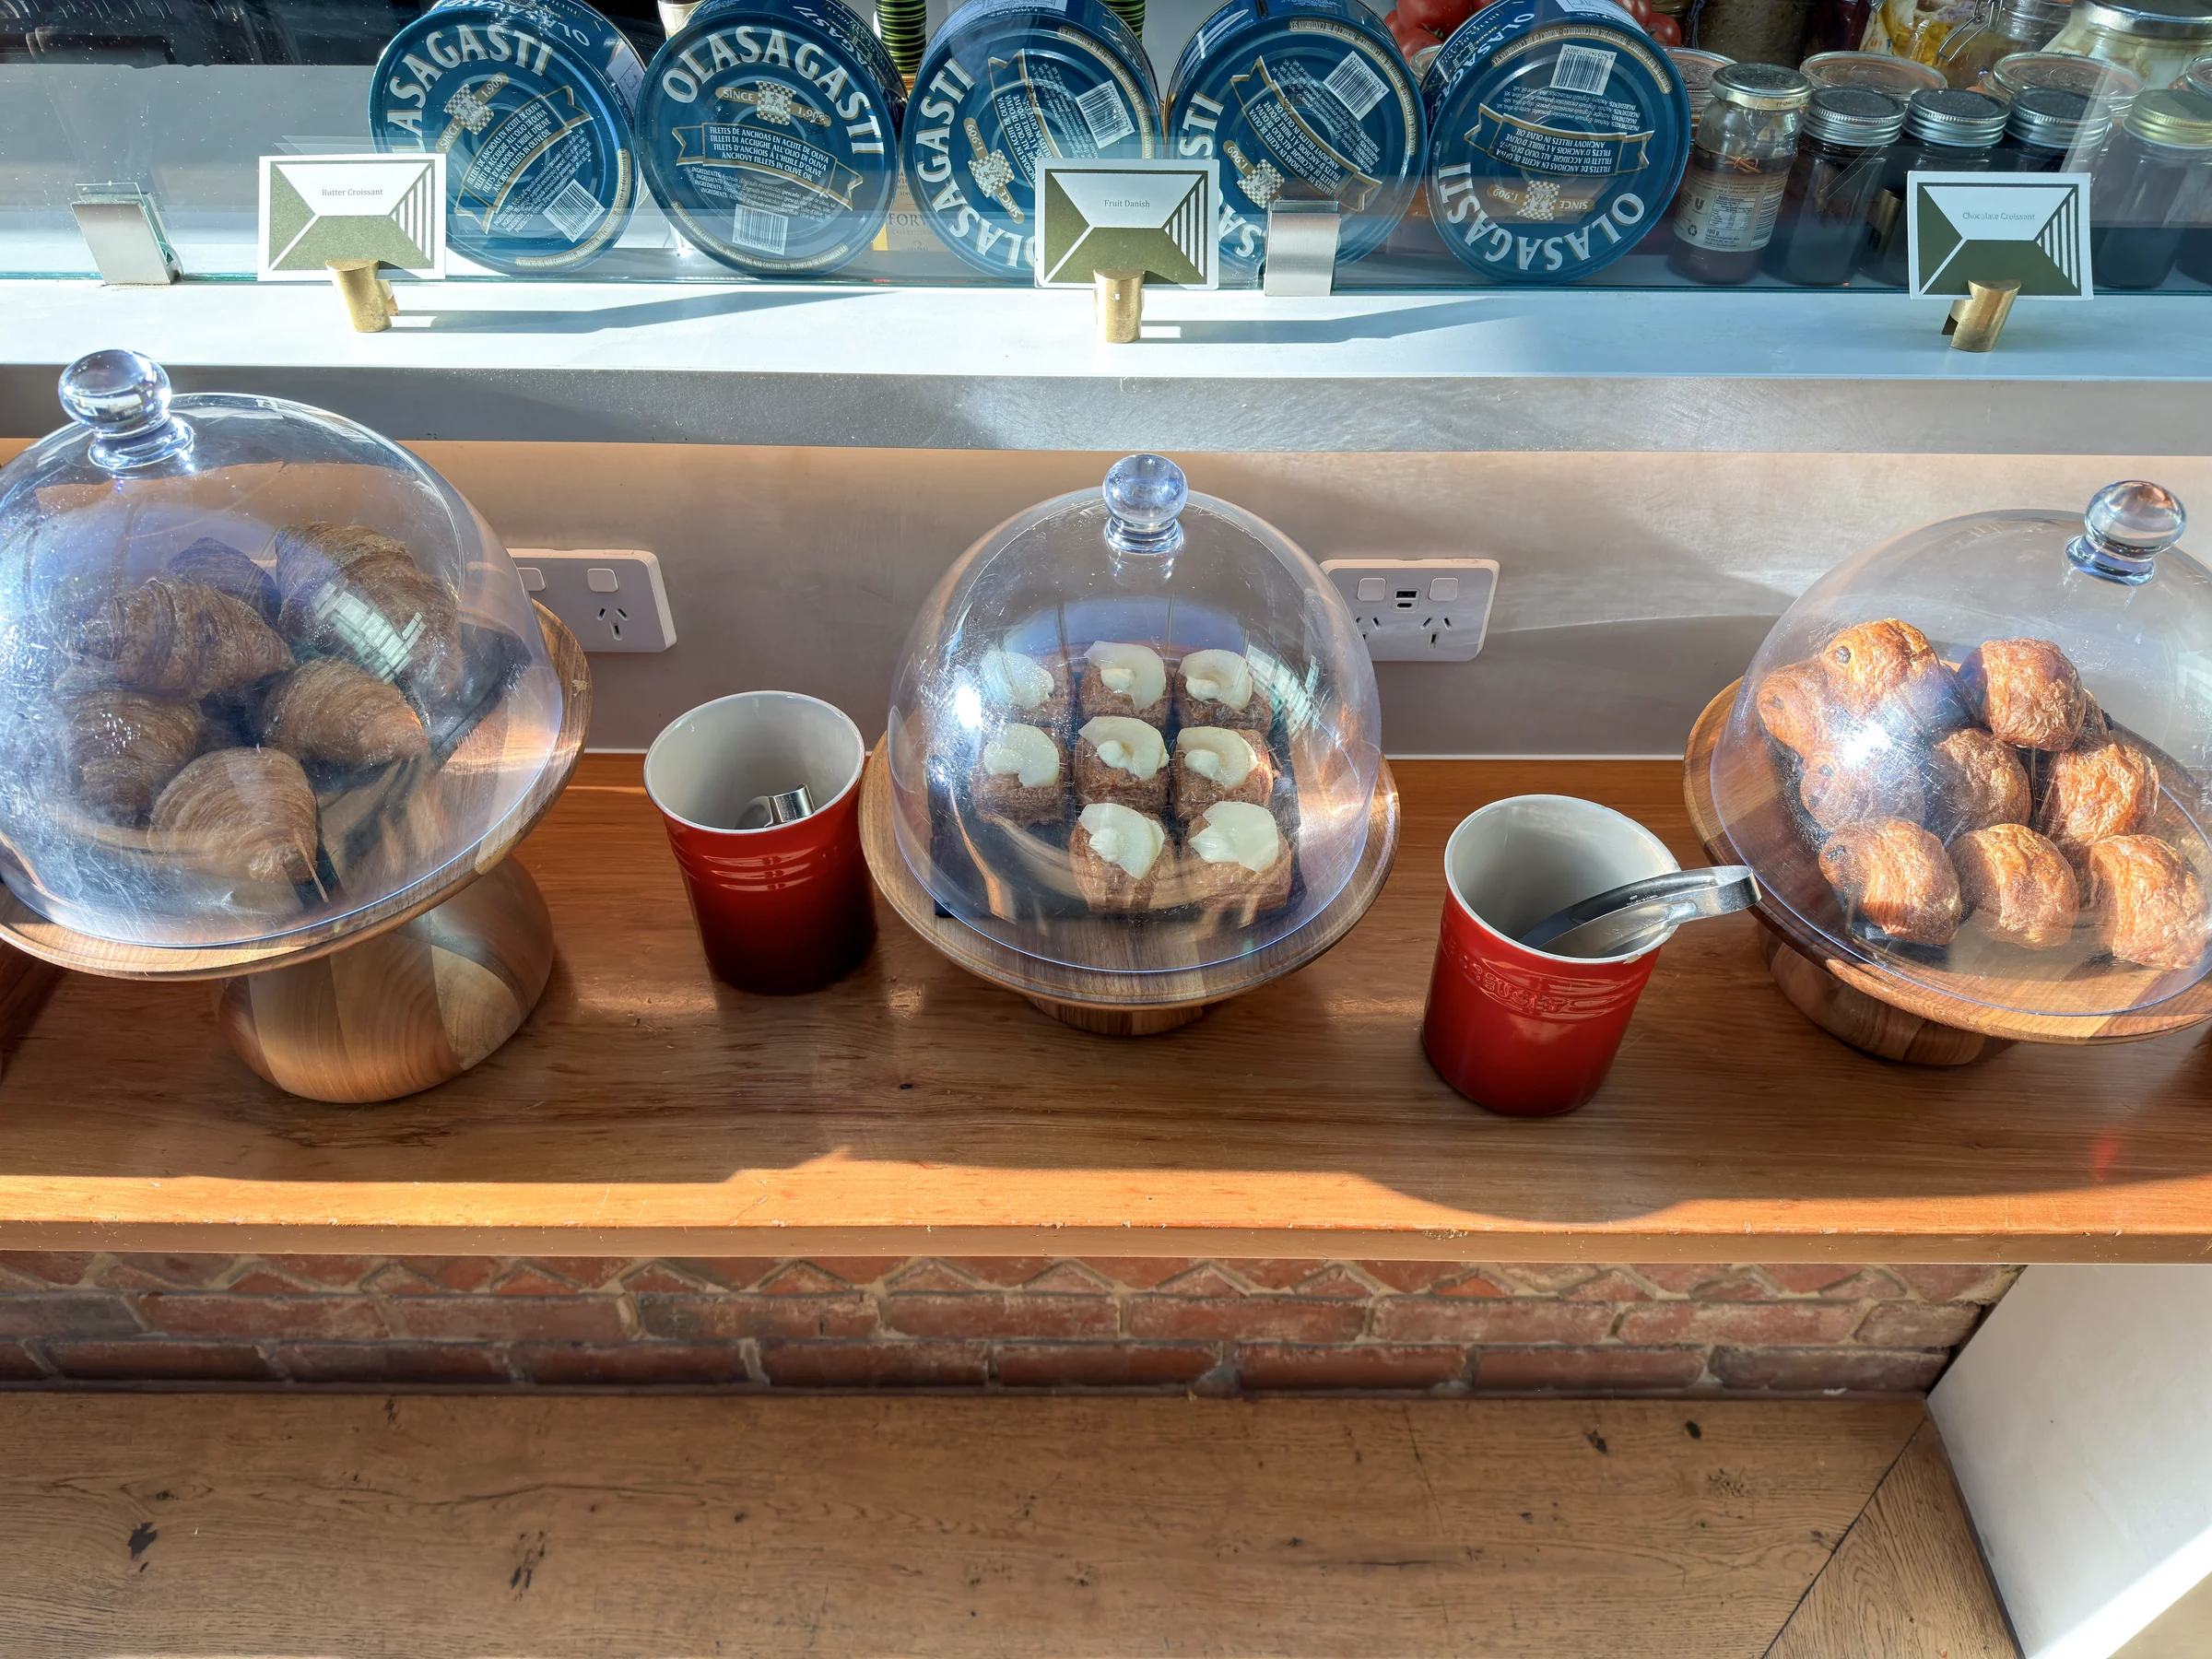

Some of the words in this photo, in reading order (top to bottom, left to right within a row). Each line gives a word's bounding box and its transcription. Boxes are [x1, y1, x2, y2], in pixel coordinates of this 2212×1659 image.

[387, 24, 553, 154] LASAGASTI
[662, 26, 885, 155] OLASAGASTI
[723, 88, 754, 102] SINCE
[440, 123, 461, 149] SINCE
[481, 75, 503, 99] 1.909
[997, 97, 1008, 116] OLIVA
[1005, 95, 1016, 114] OLIVA
[1255, 103, 1270, 123] OLIVA
[1274, 101, 1285, 113] OIL
[1003, 117, 1011, 125] DE
[1026, 112, 1039, 130] OLIVE
[1248, 109, 1264, 127] OLIVA
[1266, 120, 1274, 129] DI
[1281, 111, 1296, 128] OLIVE
[967, 124, 984, 151] 1.909
[1006, 126, 1020, 147] ACEITE
[1260, 125, 1268, 135] DE
[1293, 125, 1300, 135] IN
[1516, 128, 1525, 136] OIL
[1526, 131, 1544, 141] OLIVE
[467, 166, 481, 185] FILETES
[477, 159, 485, 168] DE
[481, 135, 501, 160] ANCHOAS
[499, 130, 507, 138] EN
[504, 116, 522, 133] ACEITE
[519, 112, 528, 120] DE
[524, 102, 542, 115] OLIVA
[710, 126, 731, 135] FILETES
[732, 127, 740, 135] DE
[742, 129, 771, 141] ANCHOAS
[782, 138, 802, 152] ACEITE
[803, 146, 810, 154] DE
[811, 150, 829, 163] OLIVA
[1265, 132, 1281, 151] ACEITE
[1298, 132, 1316, 150] FILLETS
[1552, 137, 1573, 147] FILLETS
[475, 171, 487, 191] FILLETI
[484, 165, 491, 173] DI
[506, 124, 527, 146] ALL'OLIO
[530, 110, 547, 124] OLIVA
[740, 137, 771, 149] ACCIUGHE
[771, 145, 800, 159] ALL'OLIO
[809, 159, 827, 171] OLIVA
[1016, 147, 1024, 155] EN
[1227, 146, 1248, 170] 1.909
[1278, 148, 1288, 158] EN
[1289, 147, 1316, 172] ACCIUGHE
[1313, 147, 1340, 170] ANCHOVY
[1524, 149, 1551, 160] ALL'OLIO
[1552, 155, 1583, 164] ACCIUGHE
[493, 166, 513, 193] ANCHOVY
[510, 151, 525, 169] FILLETS
[523, 146, 531, 154] IN
[527, 135, 544, 149] OLIVE
[541, 129, 552, 138] OIL
[721, 152, 752, 162] ANCHOVY
[754, 157, 775, 168] FILLETS
[776, 161, 783, 170] IN
[784, 164, 802, 177] OLIVE
[803, 171, 813, 182] OIL
[735, 145, 769, 157] D'ANCHOIS
[770, 150, 774, 159] À
[776, 153, 797, 167] L'HUILE
[799, 162, 822, 178] D'OLIVE
[1285, 155, 1309, 178] ANCHOAS
[1522, 157, 1540, 167] ACEITE
[1550, 163, 1580, 171] ANCHOAS
[1307, 174, 1316, 182] DE
[1313, 169, 1322, 177] DI
[1319, 173, 1338, 190] FILLETI
[1323, 166, 1341, 182] FILETS
[482, 175, 495, 194] FILETS
[1314, 180, 1333, 196] FILETES
[1492, 188, 1519, 201] 1.909
[998, 191, 1022, 218] SINCE
[1559, 200, 1588, 210] SINCE
[1438, 162, 1645, 271] OLASAGASTI
[1963, 212, 1999, 220] Chocolate
[2000, 212, 2035, 220] Croissant
